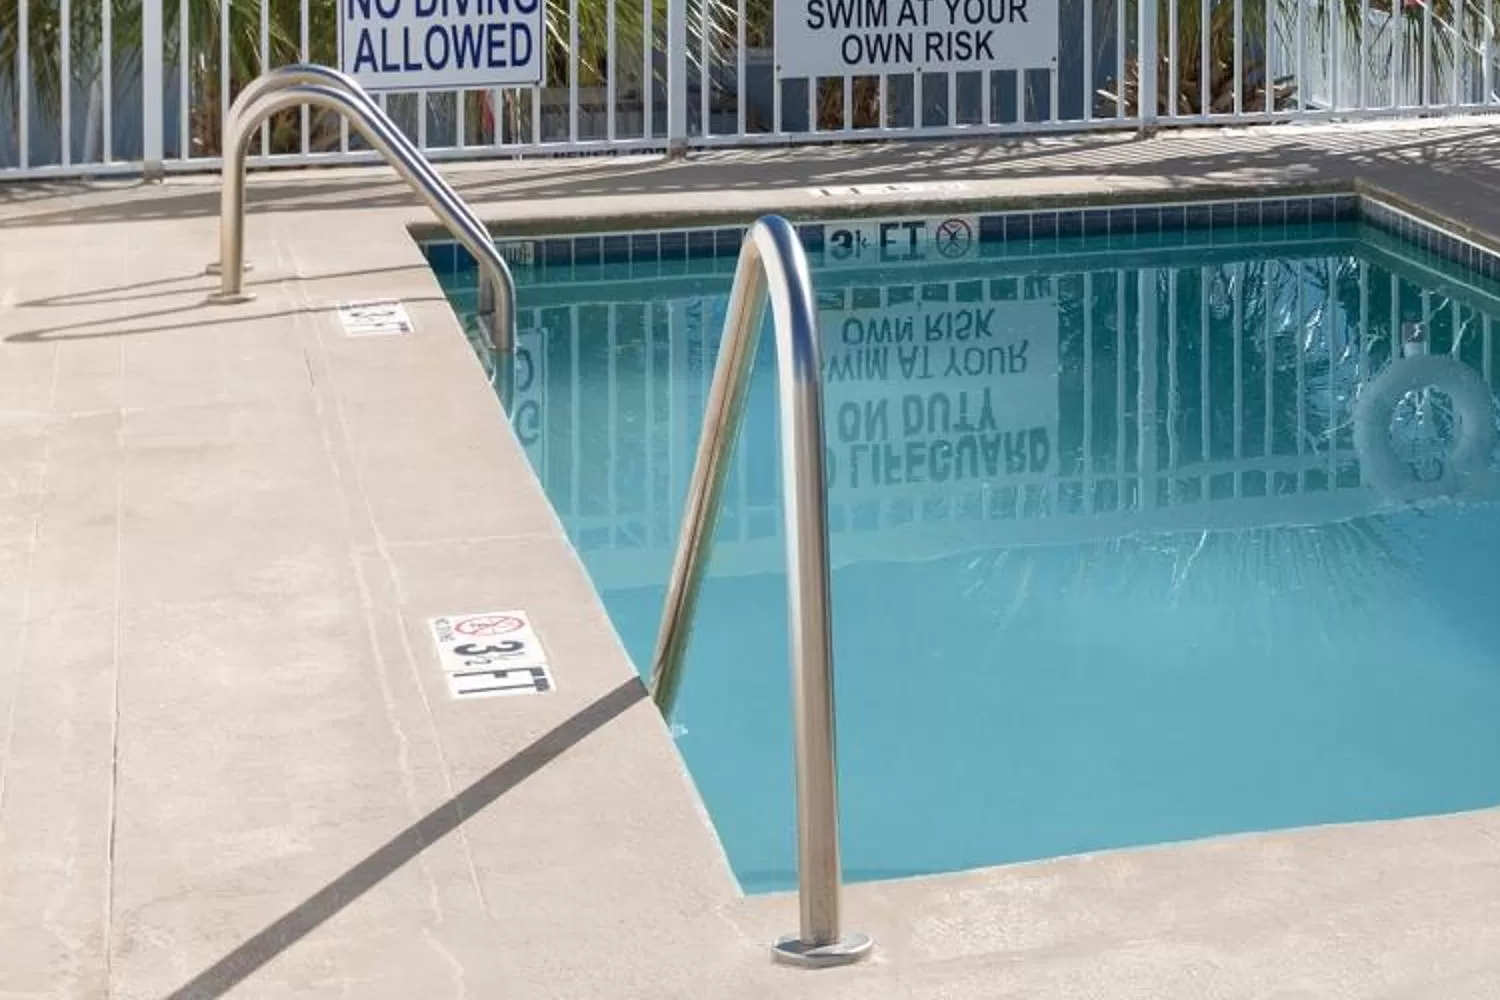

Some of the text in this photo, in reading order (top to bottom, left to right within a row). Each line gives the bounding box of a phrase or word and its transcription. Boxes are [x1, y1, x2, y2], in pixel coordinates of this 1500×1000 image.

[353, 22, 533, 74] ALLOWED
[841, 30, 995, 65] OWN RISK
[452, 666, 551, 695] FT
